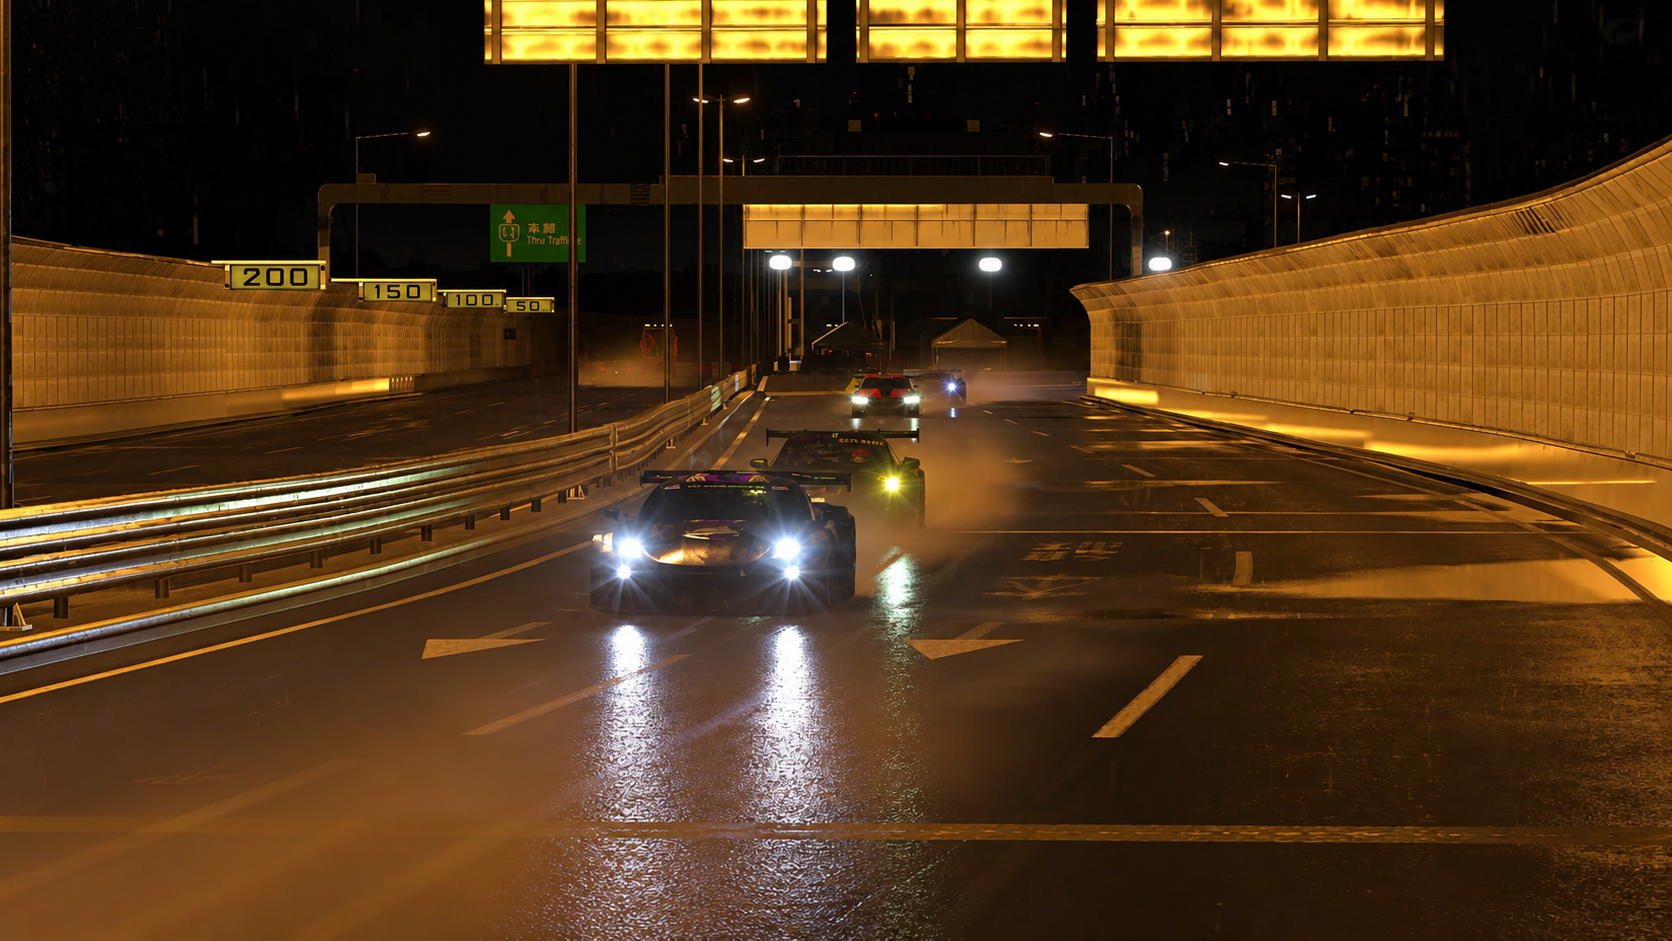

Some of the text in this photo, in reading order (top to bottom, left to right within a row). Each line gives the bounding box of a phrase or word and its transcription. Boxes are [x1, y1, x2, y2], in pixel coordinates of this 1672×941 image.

[526, 235, 546, 246] Thru
[244, 267, 308, 287] 200
[375, 284, 421, 299] 150
[455, 294, 494, 307] 100
[516, 301, 540, 312] 50
